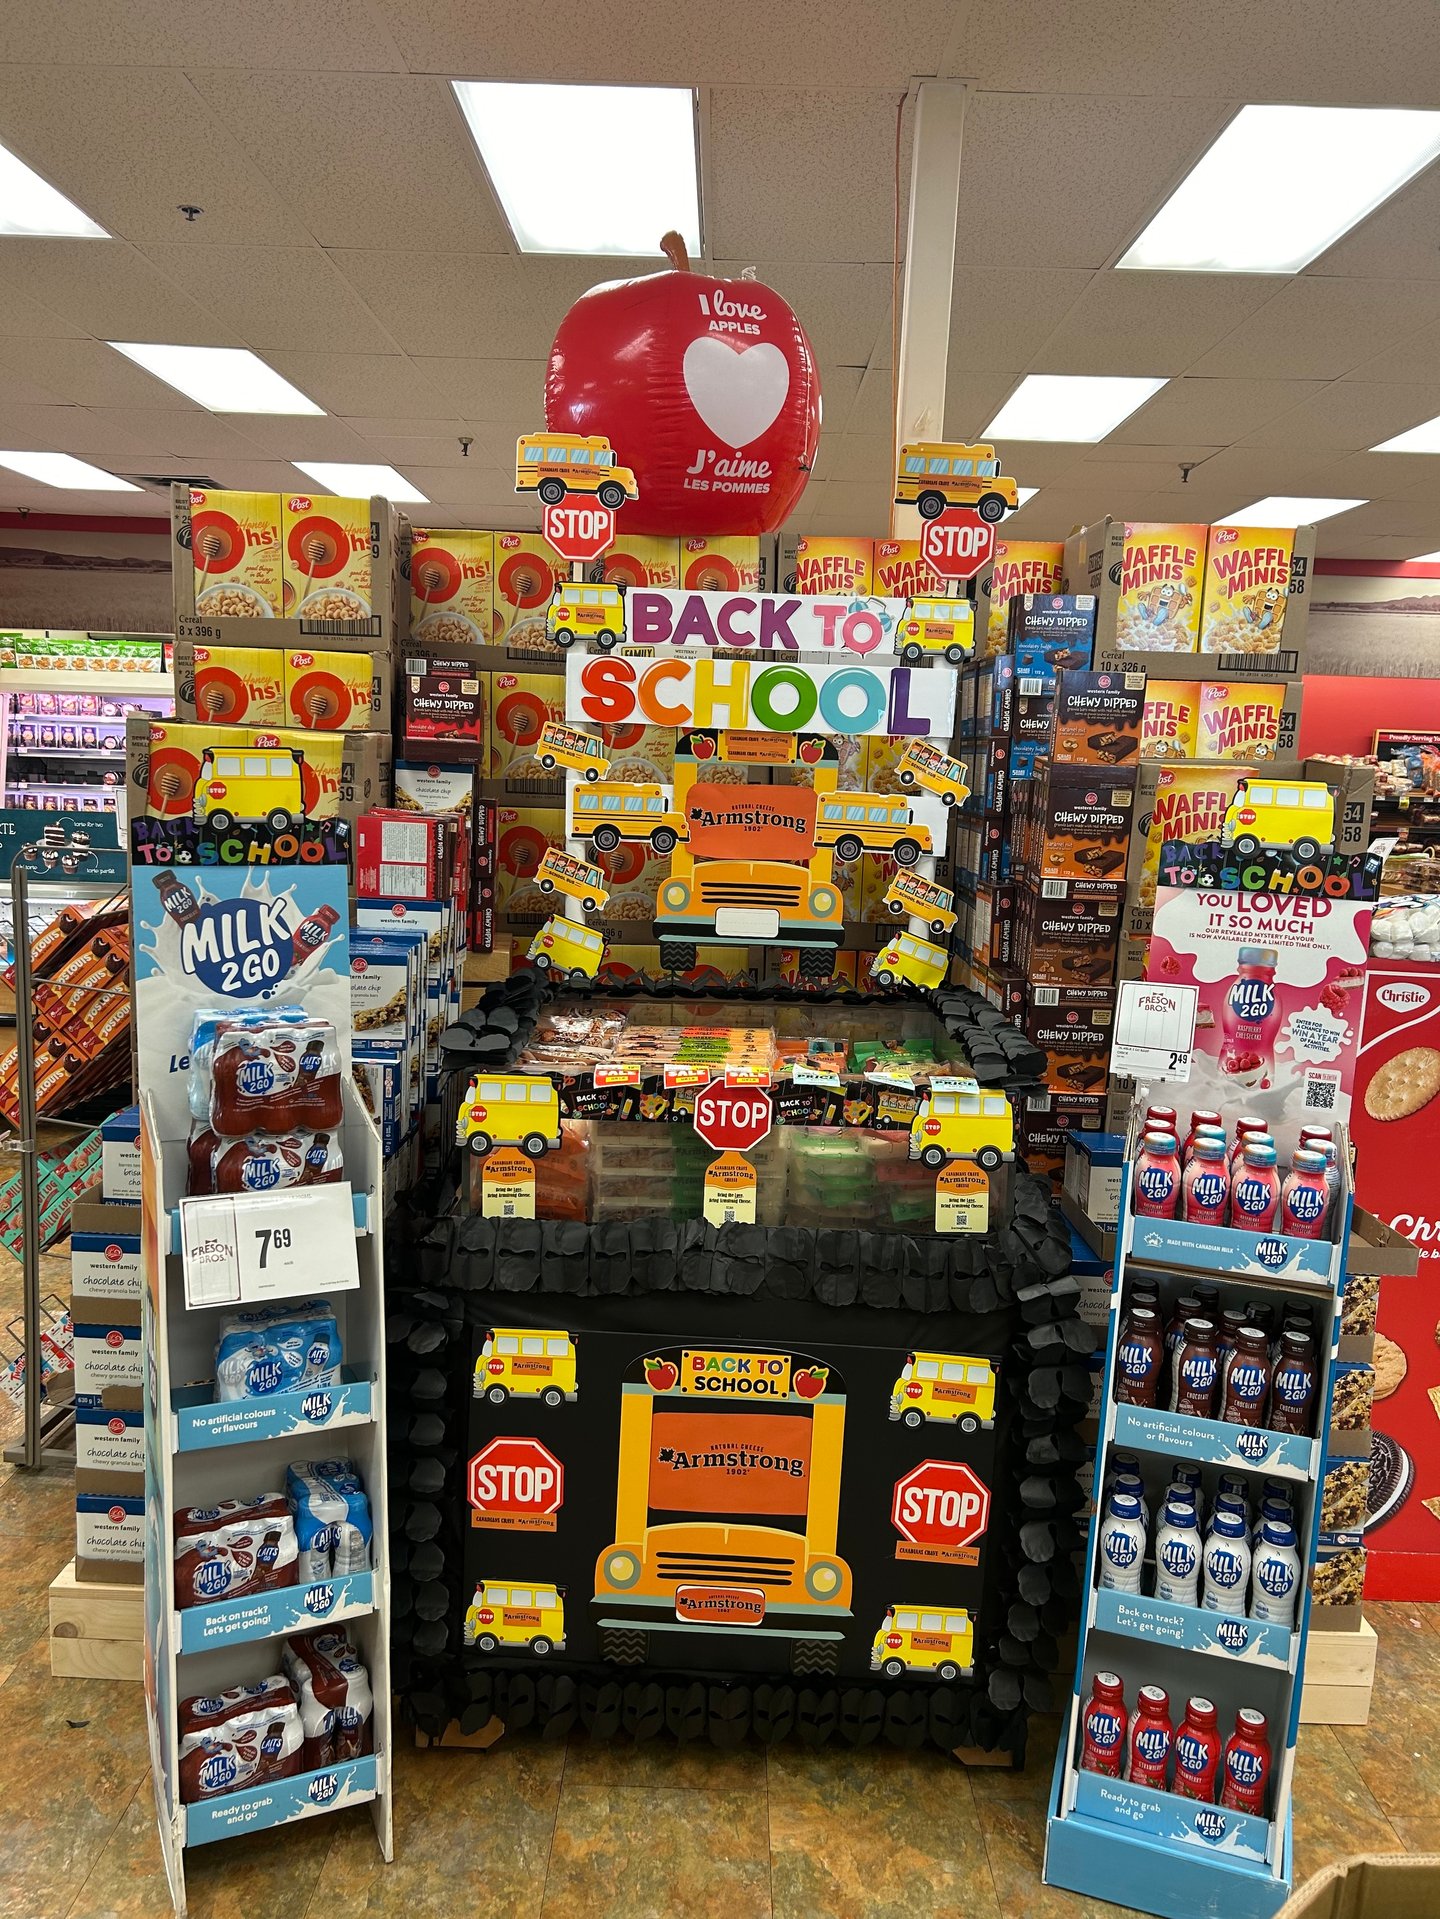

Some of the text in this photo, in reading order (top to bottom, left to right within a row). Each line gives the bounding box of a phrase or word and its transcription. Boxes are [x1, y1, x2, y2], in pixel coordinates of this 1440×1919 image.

[698, 289, 768, 321] I love
[708, 320, 761, 336] APPLES
[686, 449, 773, 479] J'aime
[683, 478, 771, 494] LES POMMES
[290, 498, 311, 510] Post
[549, 508, 609, 540] STOP
[928, 525, 989, 558] STOP
[1217, 530, 1237, 542] Post
[1227, 565, 1289, 600] MINIS
[179, 615, 203, 624] Cereal
[633, 594, 885, 654] BACK TO
[1025, 616, 1088, 626] CHEWY DIPPED
[179, 626, 221, 639] 8 396 g
[1101, 651, 1125, 660] Cereal
[1100, 662, 1138, 673] 10 326
[581, 656, 932, 735] SCHOOL
[1067, 695, 1138, 709] CHEWY DIPPED
[132, 818, 200, 840] BACK
[701, 810, 807, 833] Armstrong
[137, 834, 347, 866] TO SCHOOL
[1163, 842, 1225, 862] BACK
[1164, 864, 1374, 898] TO SCHOOL
[1197, 891, 1333, 919] YOU LOVED
[1209, 913, 1314, 935] IT SO MUCH
[182, 897, 292, 975] MILK
[1212, 934, 1247, 943] AVAILABLE
[1268, 939, 1294, 948] LIMITED
[1295, 941, 1311, 949] TIME
[1312, 943, 1332, 951] ONLY.
[1222, 929, 1253, 938] REVEALED
[1254, 932, 1283, 941] MYSTERY
[1284, 935, 1315, 943] FLAVOUR
[221, 948, 281, 992] 2GO
[1228, 983, 1275, 1006] MILK
[1381, 988, 1425, 1003] Christie
[1138, 996, 1176, 1011] FRESON
[1145, 1004, 1168, 1013] BROS.
[1240, 1003, 1268, 1017] 2GO
[1292, 1028, 1308, 1038] WIN
[1316, 1033, 1339, 1044] YEAR
[1301, 1025, 1322, 1033] CHANCE
[1303, 1043, 1331, 1053] ACTIVITIES.
[1307, 1039, 1325, 1047] FAMILY
[239, 1063, 275, 1086] MILK
[1308, 1072, 1322, 1080] SCAN
[250, 1080, 269, 1092] 2GO
[576, 1093, 597, 1102] BACK
[699, 1099, 768, 1129] STOP
[713, 1170, 754, 1180] Armstrong
[1138, 1170, 1173, 1190] MILK
[1147, 1187, 1168, 1198] 2GO
[60, 1197, 73, 1213] LOG
[191, 1243, 234, 1258] FRESON
[1167, 1239, 1181, 1247] MADE
[1195, 1243, 1220, 1252] CANADIAN
[1255, 1240, 1288, 1257] MILK
[1264, 1254, 1283, 1265] 2GO
[85, 1362, 125, 1372] chocolate
[692, 1356, 784, 1375] BACK TO
[1182, 1358, 1217, 1377] MILK
[694, 1376, 779, 1395] SCHOOL
[1192, 1376, 1213, 1388] 2GO
[301, 1392, 332, 1414] MILK
[192, 1408, 276, 1428] No artificial colours
[310, 1407, 328, 1419] 2GO
[211, 1420, 258, 1434] or flavours
[1127, 1416, 1215, 1441] No artificial colours
[1146, 1433, 1194, 1447] or flavours
[673, 1450, 804, 1477] Armstrong
[477, 1464, 554, 1503] STOP
[902, 1486, 980, 1528] STOP
[1206, 1552, 1242, 1573] MILK
[1215, 1572, 1237, 1584] 2GO
[686, 1598, 761, 1614] Armstrong
[205, 1605, 269, 1626] Back on track?
[1118, 1604, 1185, 1626] Back on track?
[203, 1616, 271, 1637] Let's get going!
[1116, 1616, 1185, 1640] Let's get going!
[1135, 1730, 1170, 1750] MILK
[1145, 1748, 1167, 1760] 2GO
[211, 1797, 273, 1820] Ready to grab
[1100, 1788, 1161, 1814] Ready to grab
[226, 1812, 258, 1825] and go
[1114, 1805, 1144, 1821] and go
